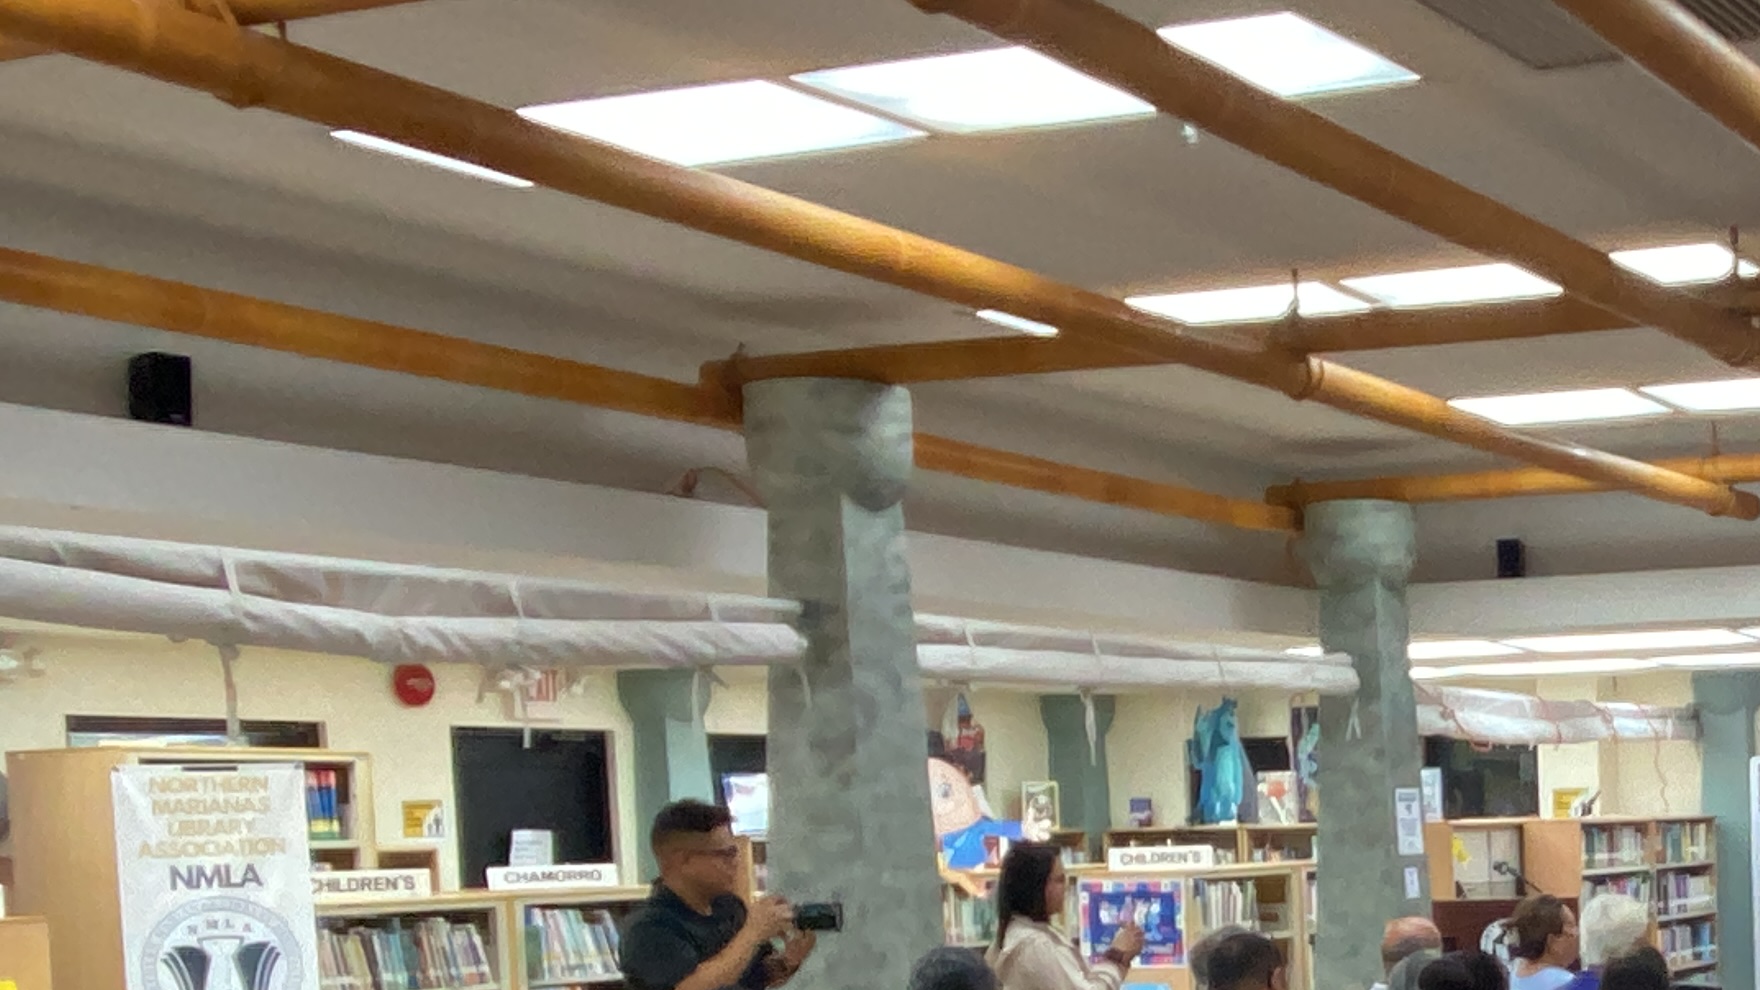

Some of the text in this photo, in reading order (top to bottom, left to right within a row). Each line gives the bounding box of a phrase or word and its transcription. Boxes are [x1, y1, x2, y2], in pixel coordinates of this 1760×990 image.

[149, 776, 269, 793] NORTHERN
[152, 797, 271, 815] MARIANAS
[167, 819, 254, 836] LIBRARY
[138, 838, 286, 858] ASSOCIATION
[170, 864, 263, 891] NMLA
[504, 870, 602, 884] CHAMORRO
